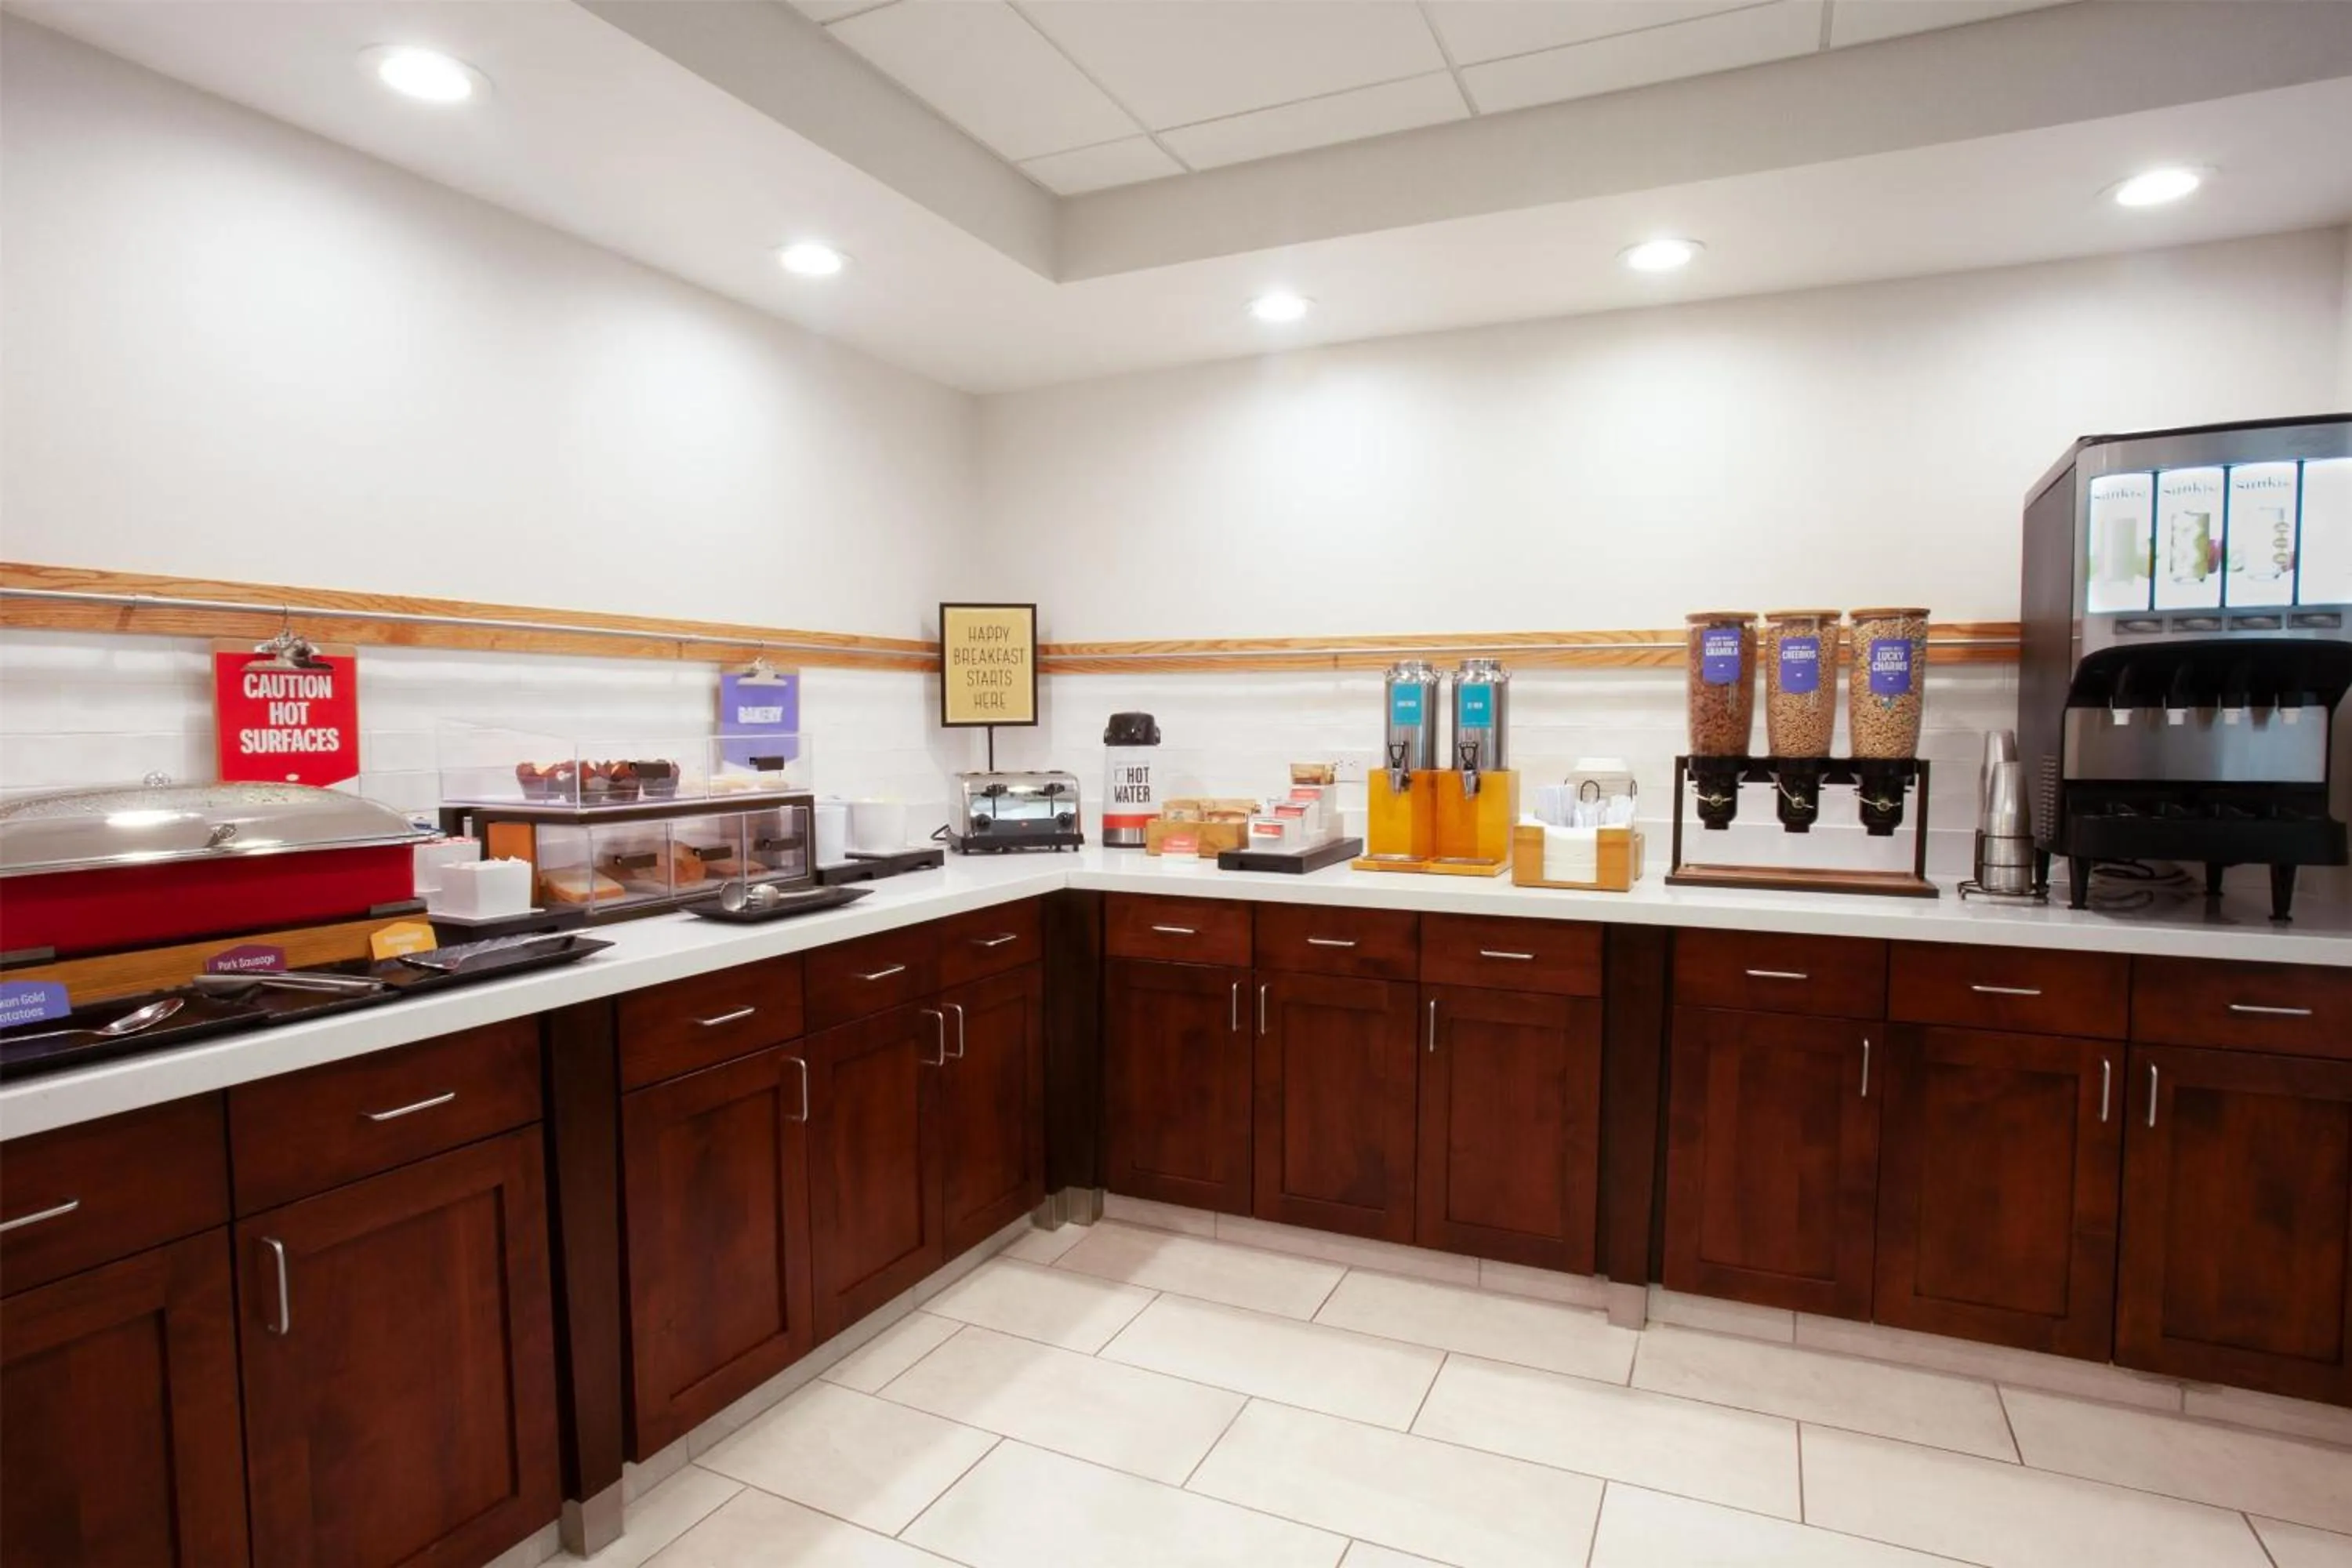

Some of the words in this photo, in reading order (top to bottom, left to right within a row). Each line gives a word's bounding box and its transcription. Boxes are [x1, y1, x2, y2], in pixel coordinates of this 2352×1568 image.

[967, 625, 1011, 642] HAPPY
[953, 647, 1025, 666] BREAKFAST
[244, 673, 333, 699] CAUTION
[967, 669, 1012, 687] STARTS
[974, 691, 1007, 710] HERE
[269, 702, 310, 725] HOT
[239, 728, 339, 753] SURFACES
[1127, 767, 1150, 784] HOT
[1114, 785, 1150, 803] WATER
[238, 954, 276, 968] Sausage
[20, 990, 45, 1004] Gold
